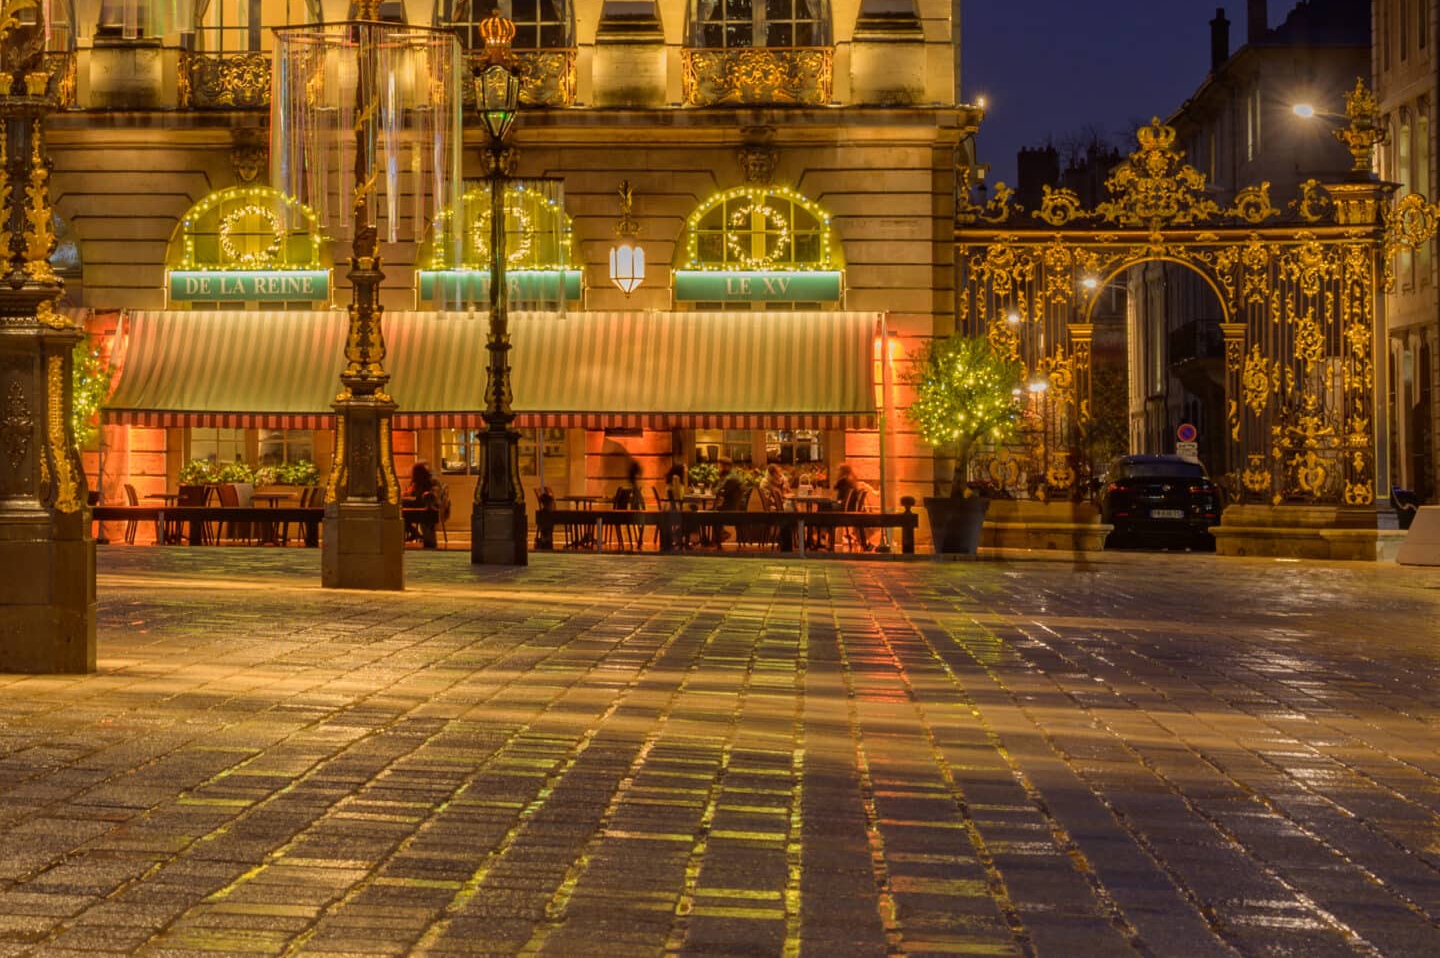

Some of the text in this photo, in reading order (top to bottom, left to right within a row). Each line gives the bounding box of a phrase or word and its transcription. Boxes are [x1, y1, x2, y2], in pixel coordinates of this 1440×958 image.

[185, 276, 313, 295] DE LA REINE
[725, 276, 792, 295] LE XV
